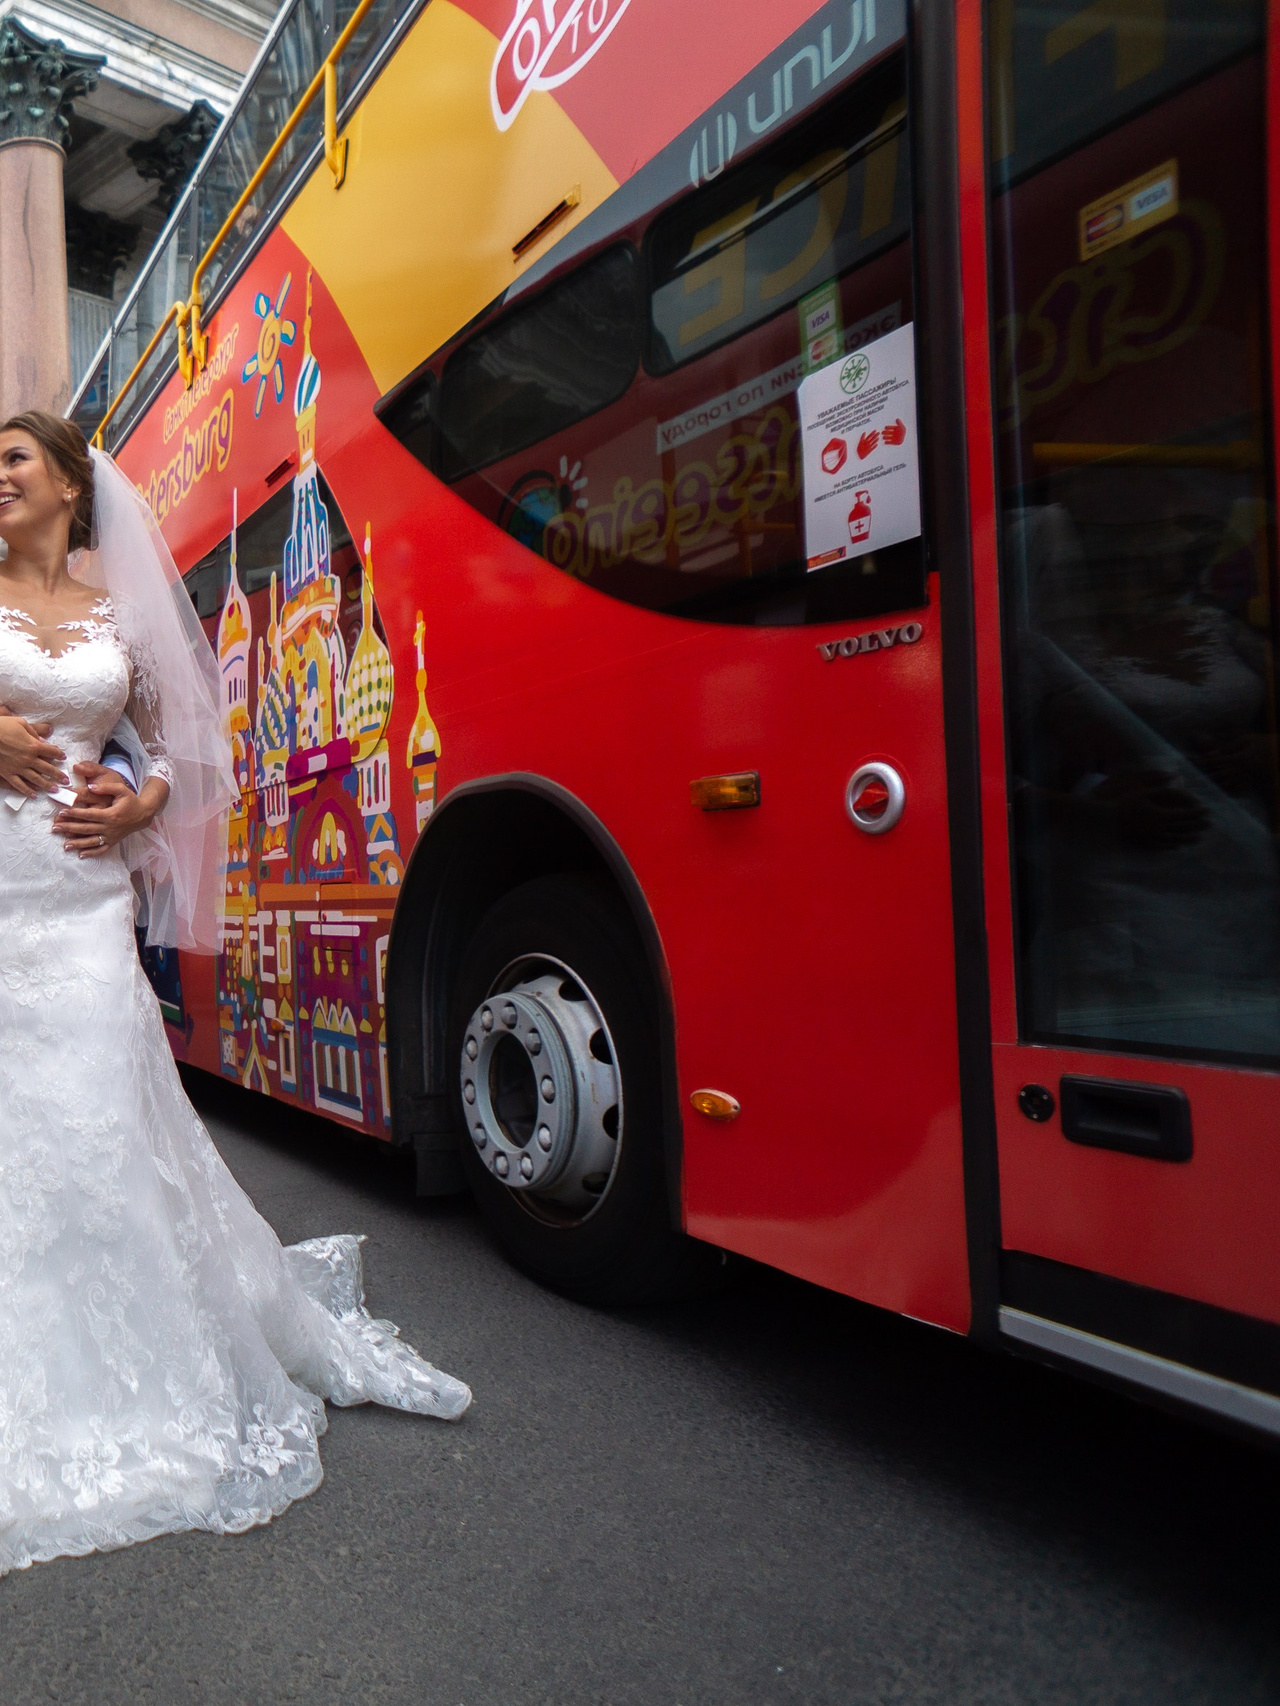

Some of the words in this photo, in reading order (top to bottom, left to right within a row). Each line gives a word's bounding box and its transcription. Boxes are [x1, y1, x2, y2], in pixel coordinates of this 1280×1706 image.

[811, 310, 830, 329] VISA
[856, 377, 896, 401] ПАССАЖИРЫ
[816, 622, 922, 661] VOLVO
